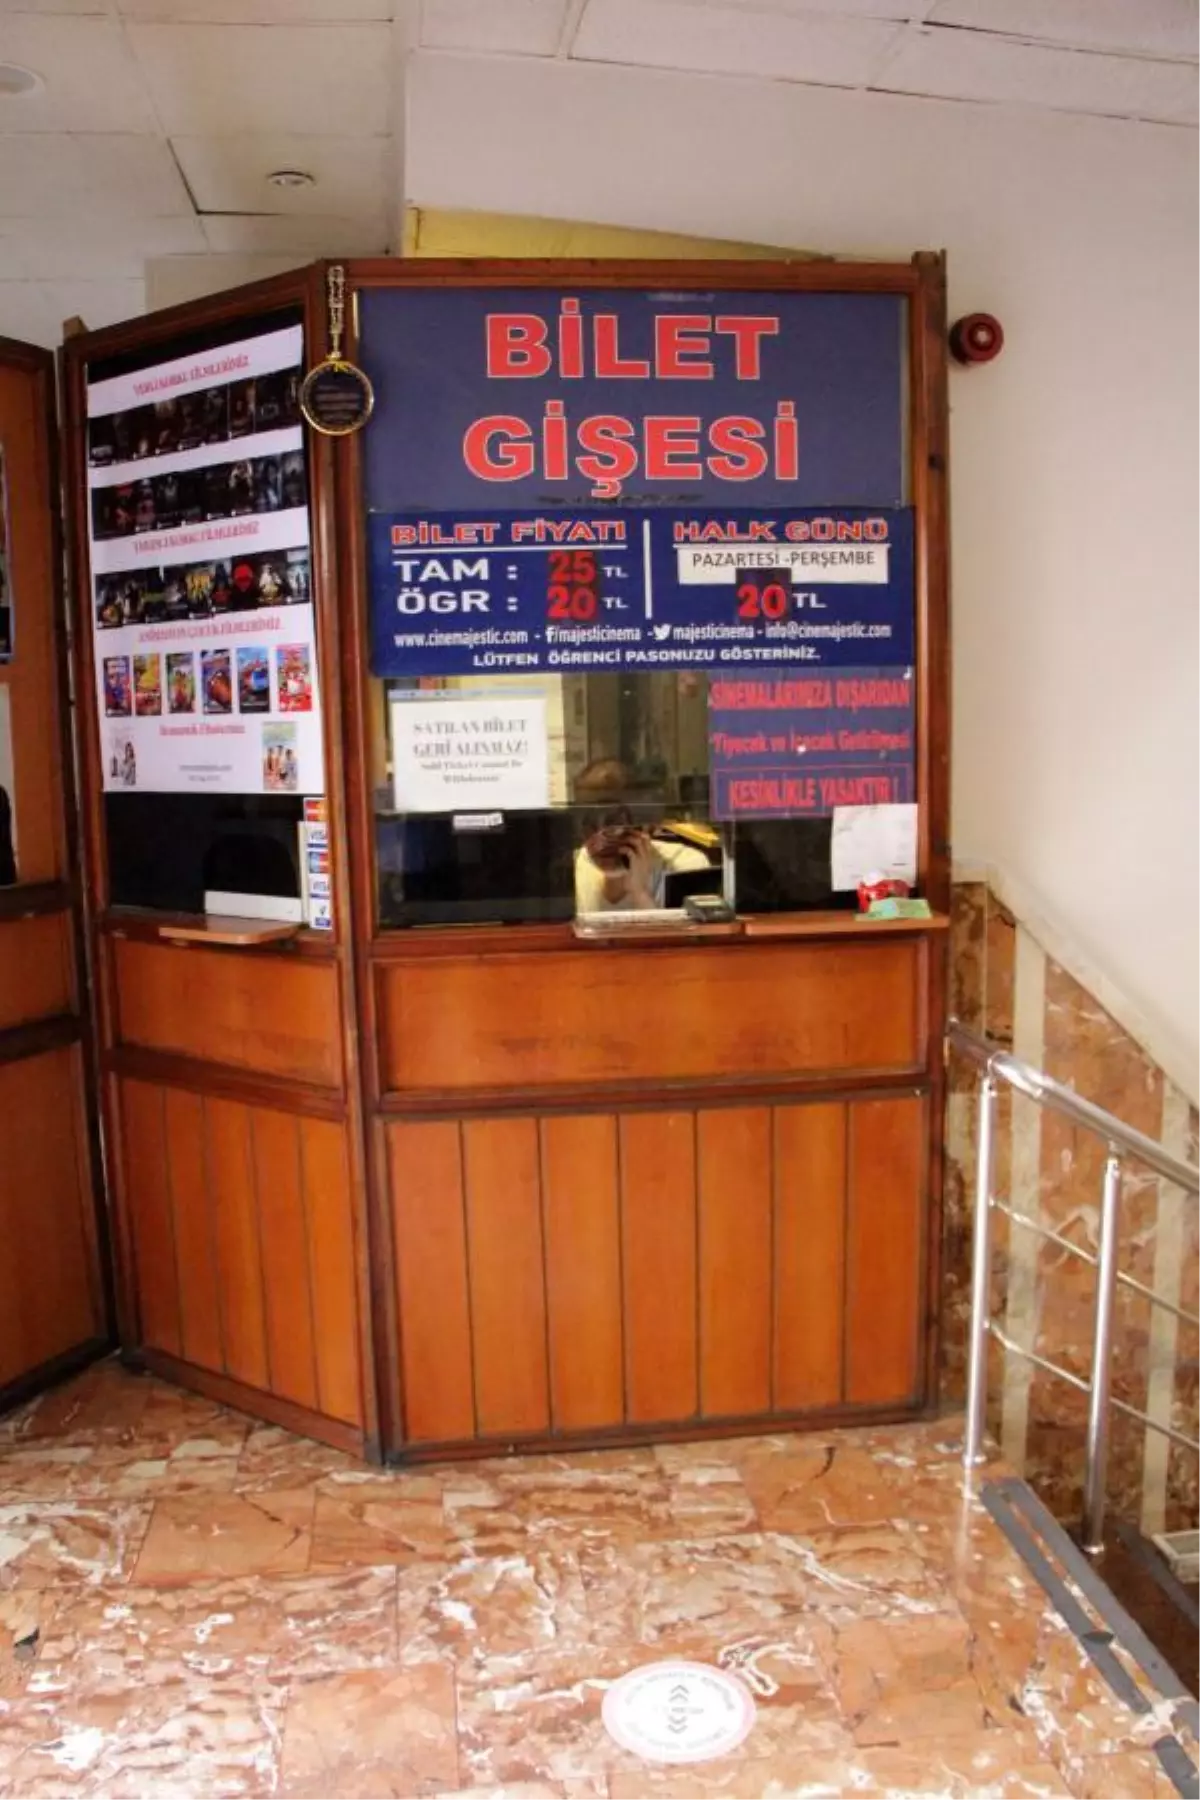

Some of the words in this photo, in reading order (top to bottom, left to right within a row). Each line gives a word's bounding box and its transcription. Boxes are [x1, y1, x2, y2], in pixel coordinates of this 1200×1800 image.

[486, 298, 779, 380] BİLET
[463, 399, 798, 498] GİŞESİ
[391, 521, 500, 545] BİLET
[511, 518, 627, 542] FİYATI
[673, 520, 778, 542] HALK
[785, 517, 889, 541] GÜNÜ
[392, 558, 490, 582] TAM
[547, 551, 596, 583] 25
[603, 566, 629, 578] TL
[692, 550, 780, 567] PAZARTESİ
[397, 587, 490, 614] ÖGR
[546, 586, 597, 620] 20
[603, 597, 629, 609] TL
[736, 583, 787, 618] 20
[793, 592, 827, 608] TL
[394, 629, 528, 649] www.cinemajestic.com
[673, 624, 754, 644] majesticinema
[765, 621, 892, 642] info@cinemajestic.com
[473, 652, 539, 667] LÜTFEN
[547, 649, 621, 664] ÖĞRENCİ
[625, 648, 715, 662] PASONUZU
[720, 645, 821, 661] GÖSTERİNİZ.
[413, 719, 480, 735] SATILAN
[483, 716, 527, 733] BİLET
[413, 740, 451, 757] GERİ
